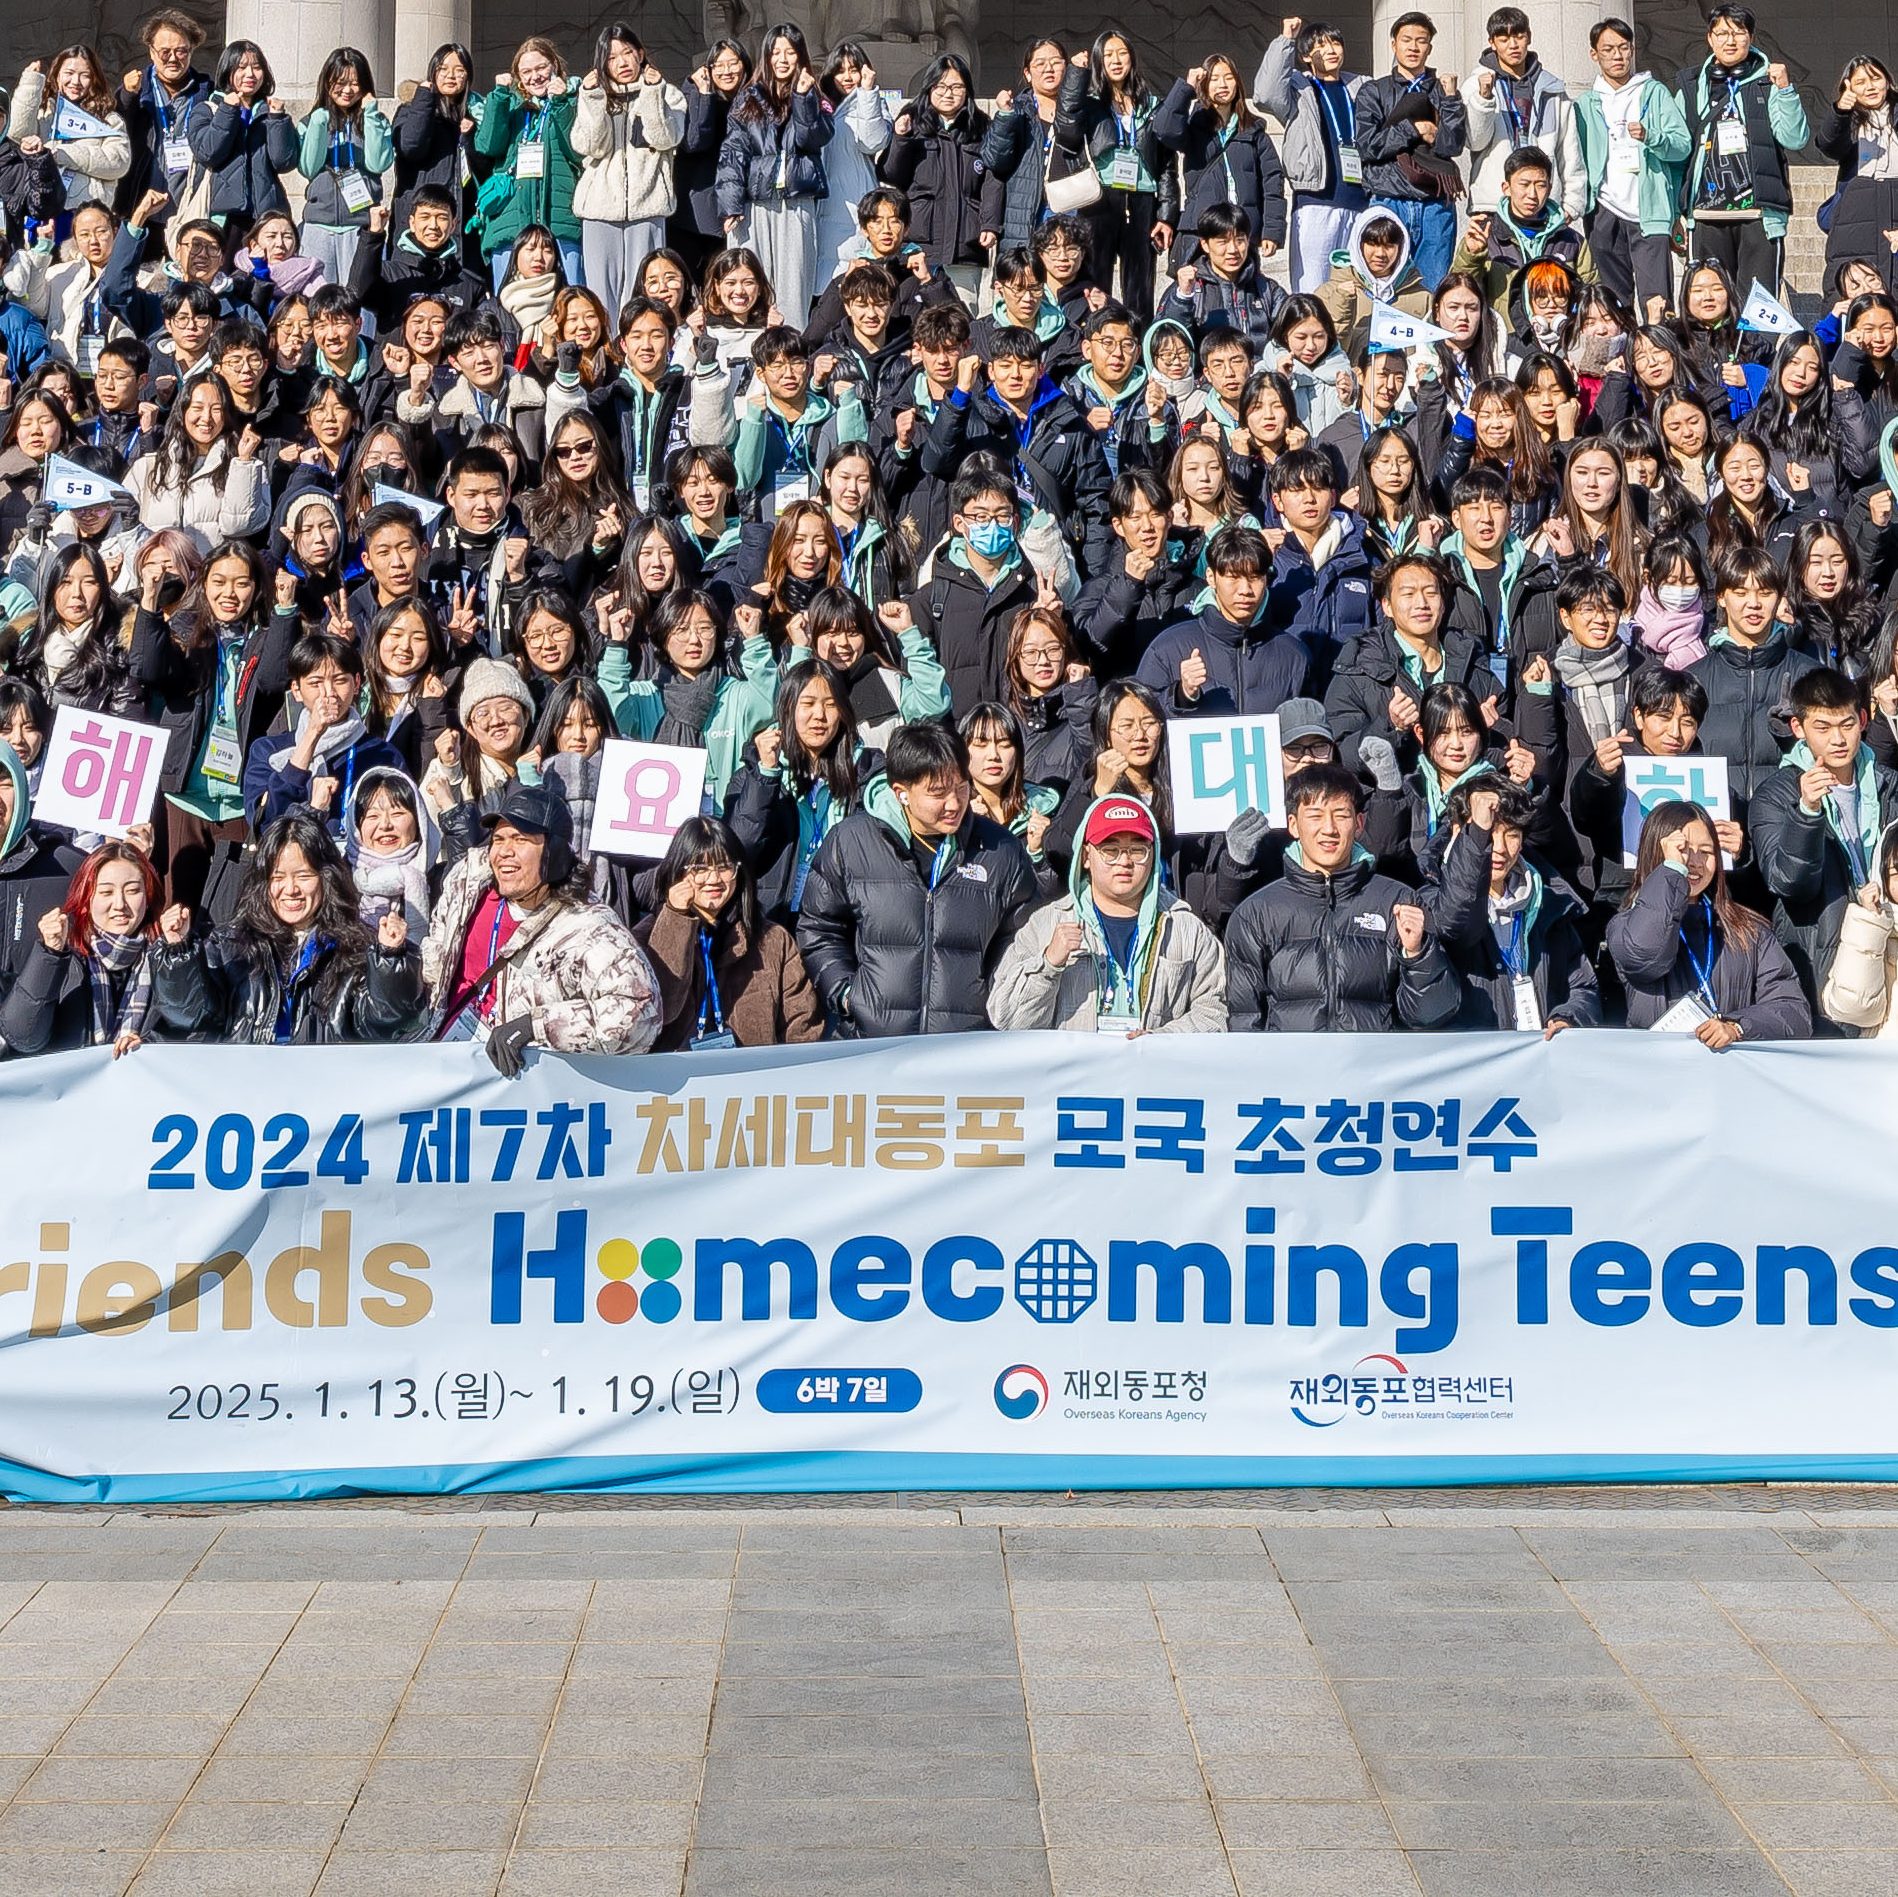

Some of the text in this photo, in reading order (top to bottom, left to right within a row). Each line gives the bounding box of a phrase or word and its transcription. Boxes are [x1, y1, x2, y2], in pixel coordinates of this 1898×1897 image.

[67, 118, 87, 132] 3-A
[1758, 308, 1779, 324] 2-B
[1390, 326, 1414, 338] 4-B
[66, 482, 92, 496] 5-B
[61, 720, 154, 826] 해
[1189, 725, 1271, 816] 대
[609, 758, 683, 837] 요
[147, 1094, 1538, 1190] 2024 제7차 차세대동포 모국 초청연수
[167, 1381, 293, 1422] 2025.
[605, 1367, 741, 1417] 19.(일)
[796, 1375, 889, 1405] 6박 7일
[1063, 1369, 1208, 1402] 재외동포청
[1064, 1408, 1207, 1423] Overseas Koreans Agency
[1382, 1410, 1414, 1420] Overseas
[1415, 1410, 1445, 1420] Koreans
[1490, 1410, 1514, 1420] Center
